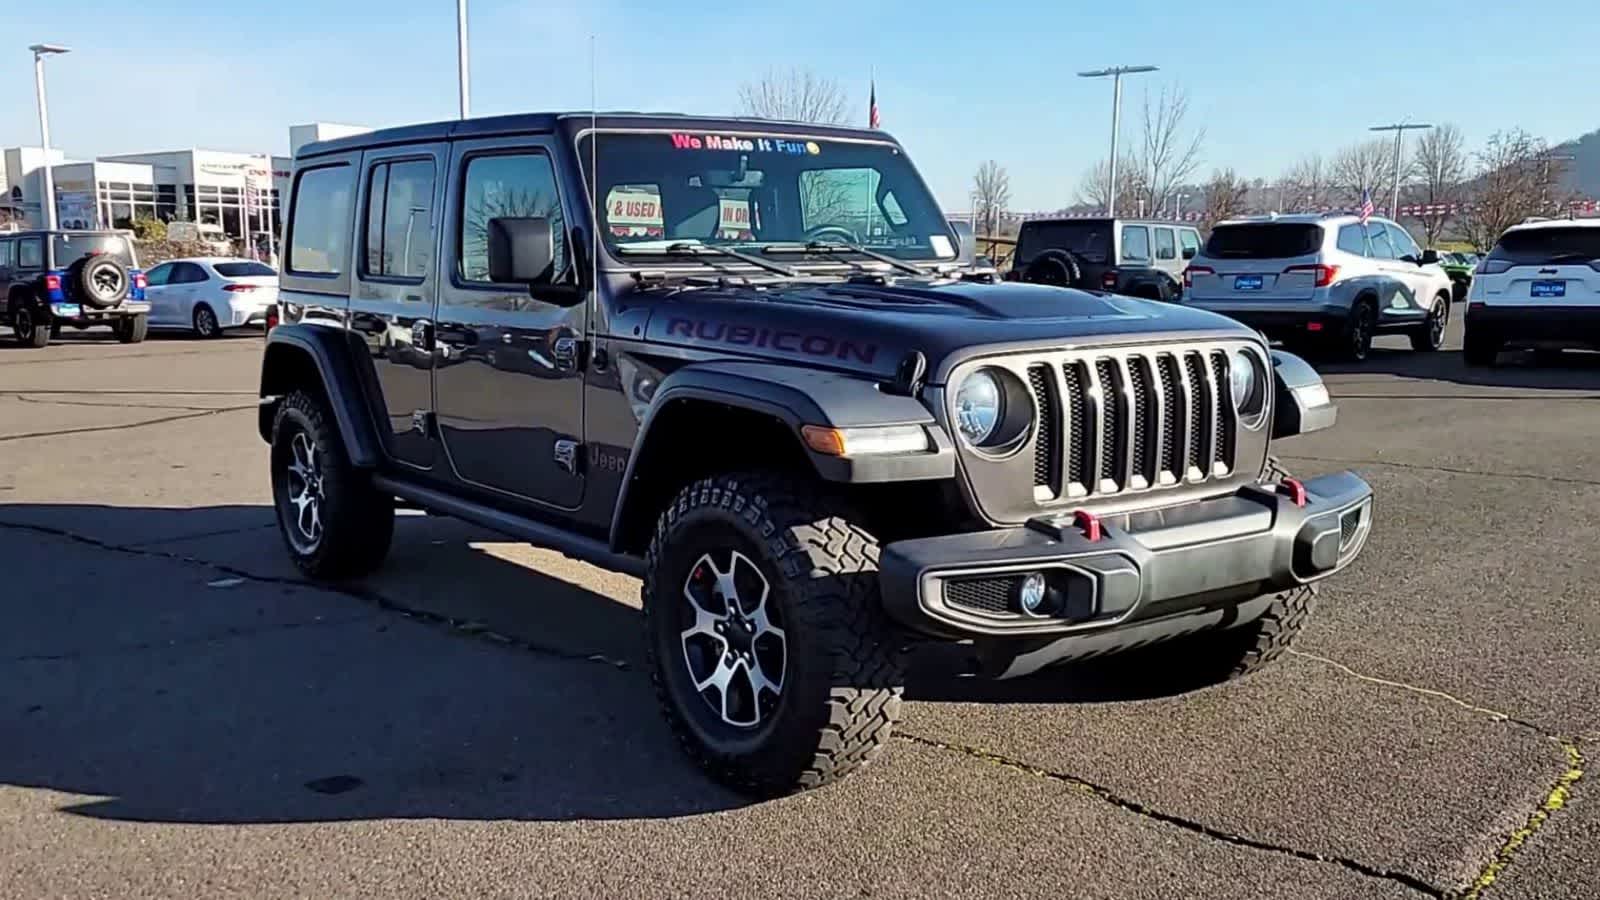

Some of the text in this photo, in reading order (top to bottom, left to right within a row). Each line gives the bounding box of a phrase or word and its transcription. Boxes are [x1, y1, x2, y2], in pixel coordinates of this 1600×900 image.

[671, 132, 806, 154] We Make It Fun
[614, 200, 655, 218] & USED
[723, 207, 733, 221] IN
[665, 316, 878, 365] RUBICON
[591, 446, 625, 473] Jeep
